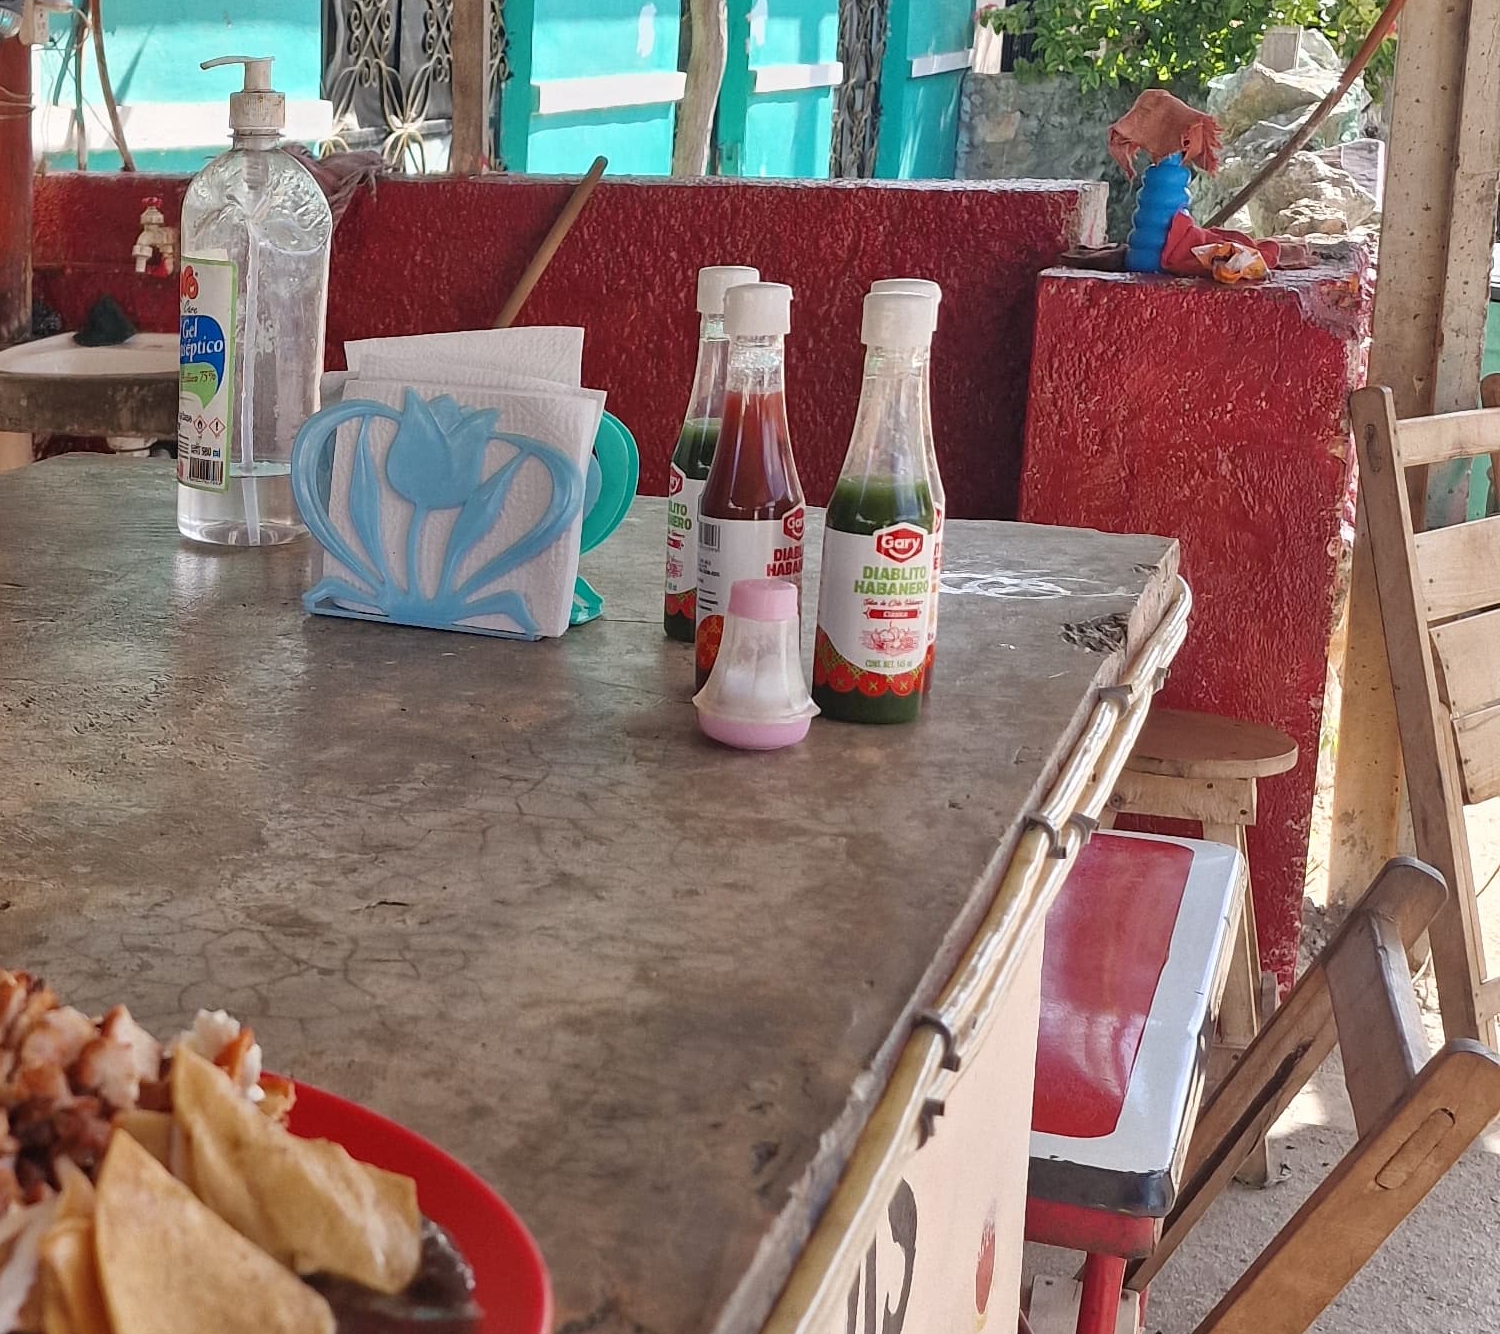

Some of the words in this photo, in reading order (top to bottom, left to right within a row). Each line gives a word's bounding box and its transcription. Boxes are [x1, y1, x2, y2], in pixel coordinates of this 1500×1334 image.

[182, 317, 198, 339] Gel
[881, 535, 921, 558] Gary
[863, 566, 927, 581] DIABLITO
[854, 580, 929, 596] HABANERO
